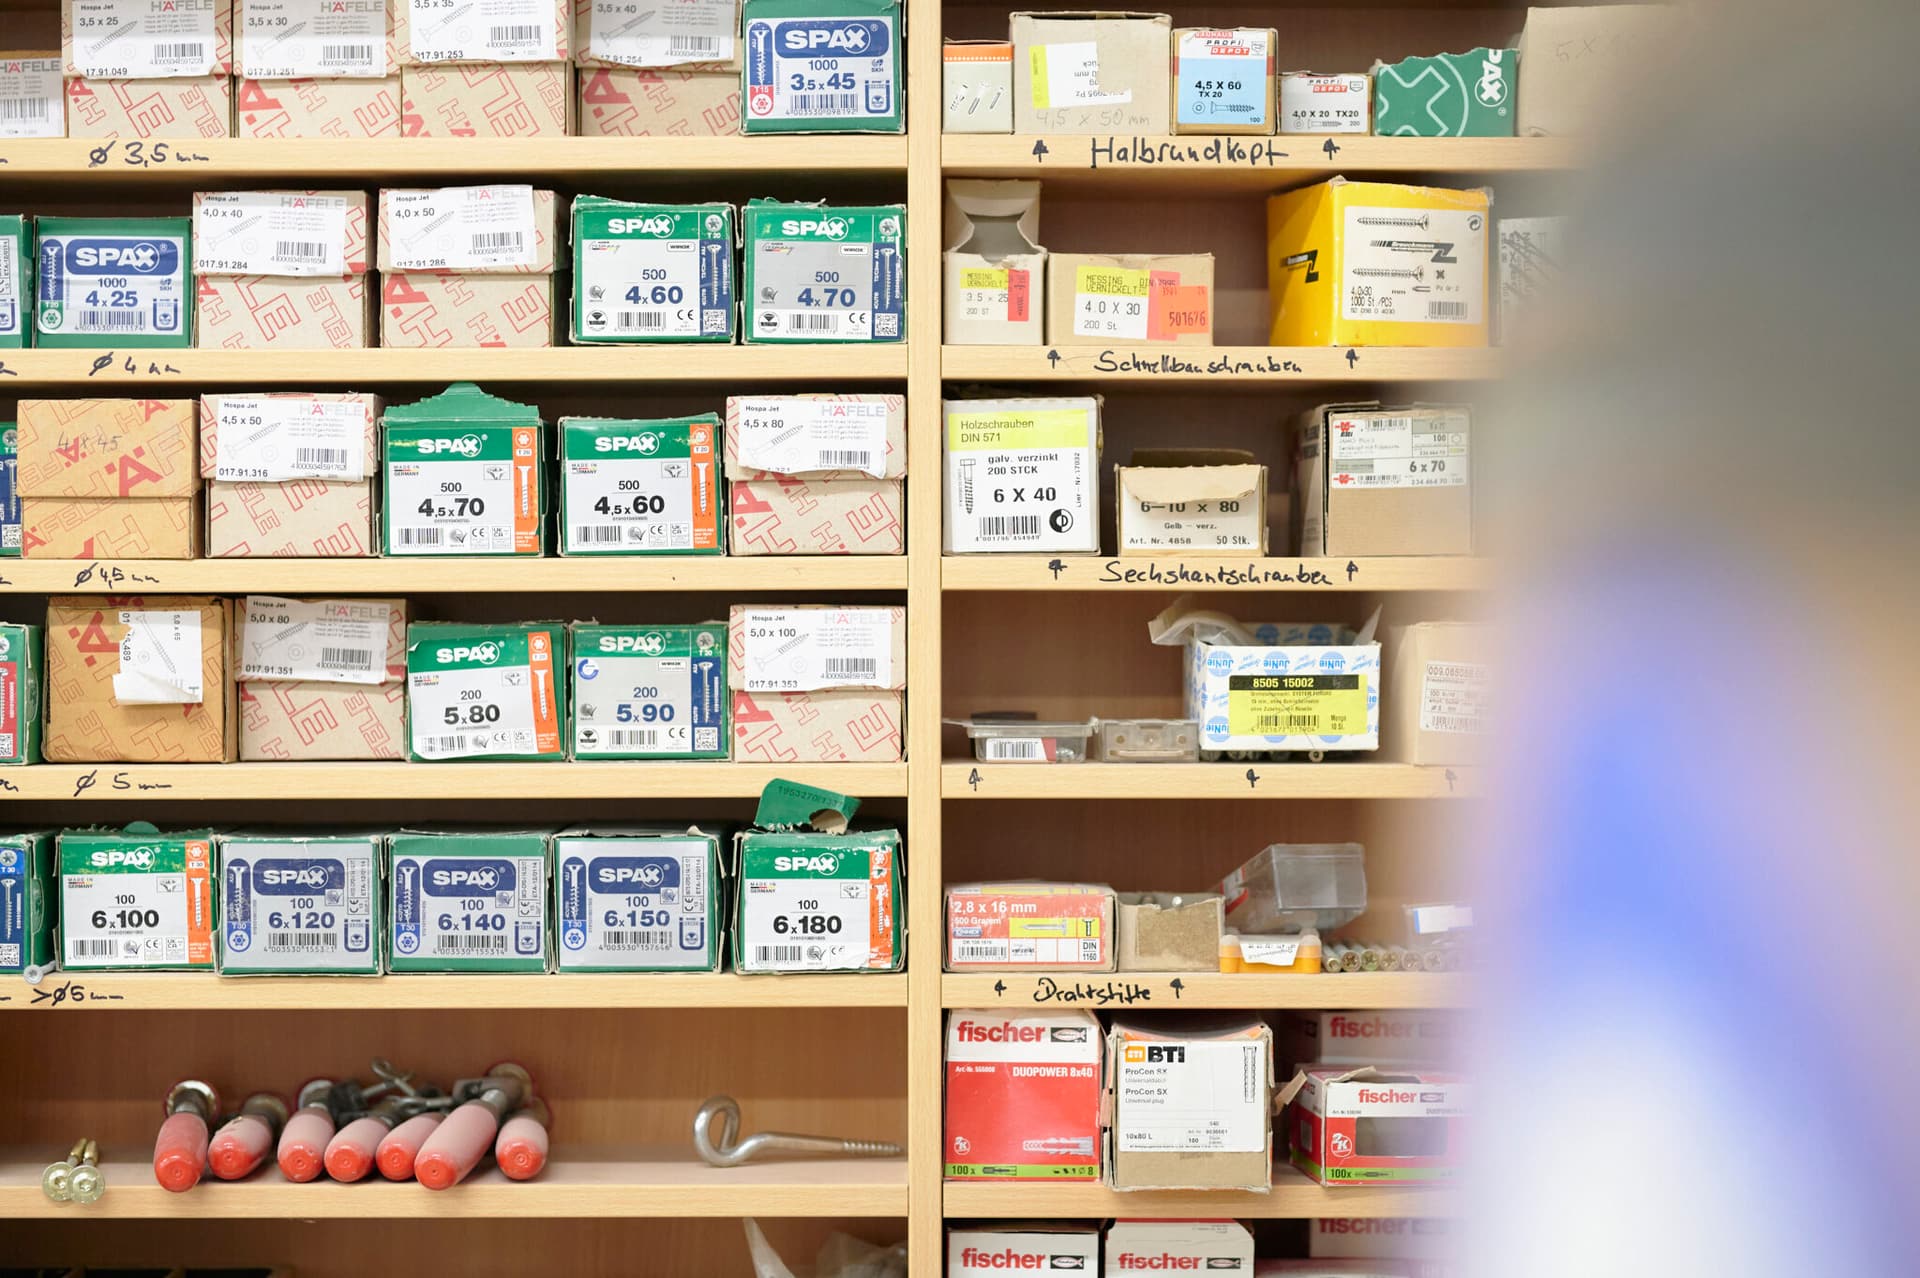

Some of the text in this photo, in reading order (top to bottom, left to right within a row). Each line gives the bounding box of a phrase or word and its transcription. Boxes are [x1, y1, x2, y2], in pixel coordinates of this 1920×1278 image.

[151, 0, 213, 12] HÄFELE
[321, 0, 383, 12] HÄFELE
[597, 3, 612, 13] 3,5
[623, 5, 637, 14] 40
[80, 17, 95, 28] 3,5
[106, 16, 119, 26] 25
[248, 17, 264, 28] 3,5
[275, 17, 288, 26] 30
[785, 25, 870, 53] SPAX
[808, 59, 839, 71] 1000
[1194, 80, 1242, 91] 4,5 X 60
[1292, 110, 1306, 119] 4,0
[1319, 110, 1330, 118] 20
[203, 208, 219, 218] 4,0
[230, 208, 243, 217] 40
[395, 209, 411, 219] 4,0
[422, 207, 435, 217] 50
[608, 217, 674, 237] SPAX
[782, 219, 847, 239] SPAX
[76, 245, 158, 270] SPAX
[199, 260, 248, 270] 017.91.284
[641, 268, 667, 281] 500
[814, 271, 840, 284] 500
[97, 277, 127, 289] 1000
[1083, 319, 1100, 330] 200
[124, 356, 137, 372] 4
[821, 404, 885, 417] HÄFELE
[221, 415, 238, 426] 4,5
[249, 415, 262, 425] 50
[743, 418, 760, 429] 4,5
[771, 418, 785, 428] 80
[960, 418, 1035, 431] Holzschrauben
[960, 431, 1001, 443] DIN 571
[1432, 434, 1447, 443] 100
[418, 436, 481, 456] SPAX
[595, 434, 659, 454] SPAX
[987, 452, 1059, 466] galv. verzinkt
[987, 464, 1039, 476] 200 STCK
[1409, 459, 1446, 473] 6 x 70
[219, 467, 269, 478] 017.91.316
[440, 481, 463, 493] 500
[618, 480, 640, 491] 500
[993, 486, 1057, 503] 6 X 40
[1215, 535, 1228, 546] 50
[1231, 535, 1251, 546] Stk.
[325, 603, 388, 619] HÄFELE
[250, 614, 266, 626] 5,0
[277, 615, 290, 625] 80
[750, 628, 766, 639] 5,0
[778, 628, 797, 638] 100
[599, 634, 665, 654] SPAX
[436, 643, 499, 665] SPAX
[245, 663, 293, 675] 017.91.351
[748, 679, 799, 690] 017.91.353
[1252, 677, 1314, 689] 8505 15002
[460, 689, 482, 702] 200
[633, 686, 658, 699] 200
[112, 772, 130, 790] 5
[91, 848, 155, 869] SPAX
[774, 853, 838, 874] SPAX
[263, 867, 328, 887] SPAX
[433, 868, 499, 889] SPAX
[599, 865, 663, 886] SPAX
[115, 894, 135, 905] 100
[290, 897, 314, 910] 100
[460, 899, 484, 911] 100
[625, 896, 649, 908] 100
[797, 900, 819, 910] 100
[954, 900, 1037, 915] 2,8 x 16 mm
[1082, 941, 1097, 951] DIN
[1082, 952, 1097, 962] 1160
[957, 1021, 1046, 1043] fischer
[1329, 1016, 1417, 1039] fischer
[1147, 1045, 1186, 1063] BTI
[1012, 1066, 1093, 1078] DUOPOWER 8x40
[1125, 1088, 1168, 1096] ProCon SX
[1358, 1088, 1416, 1104] fischer
[1330, 1168, 1352, 1179] 100x
[961, 1247, 1046, 1270] fischer
[1118, 1252, 1202, 1270] fischer
